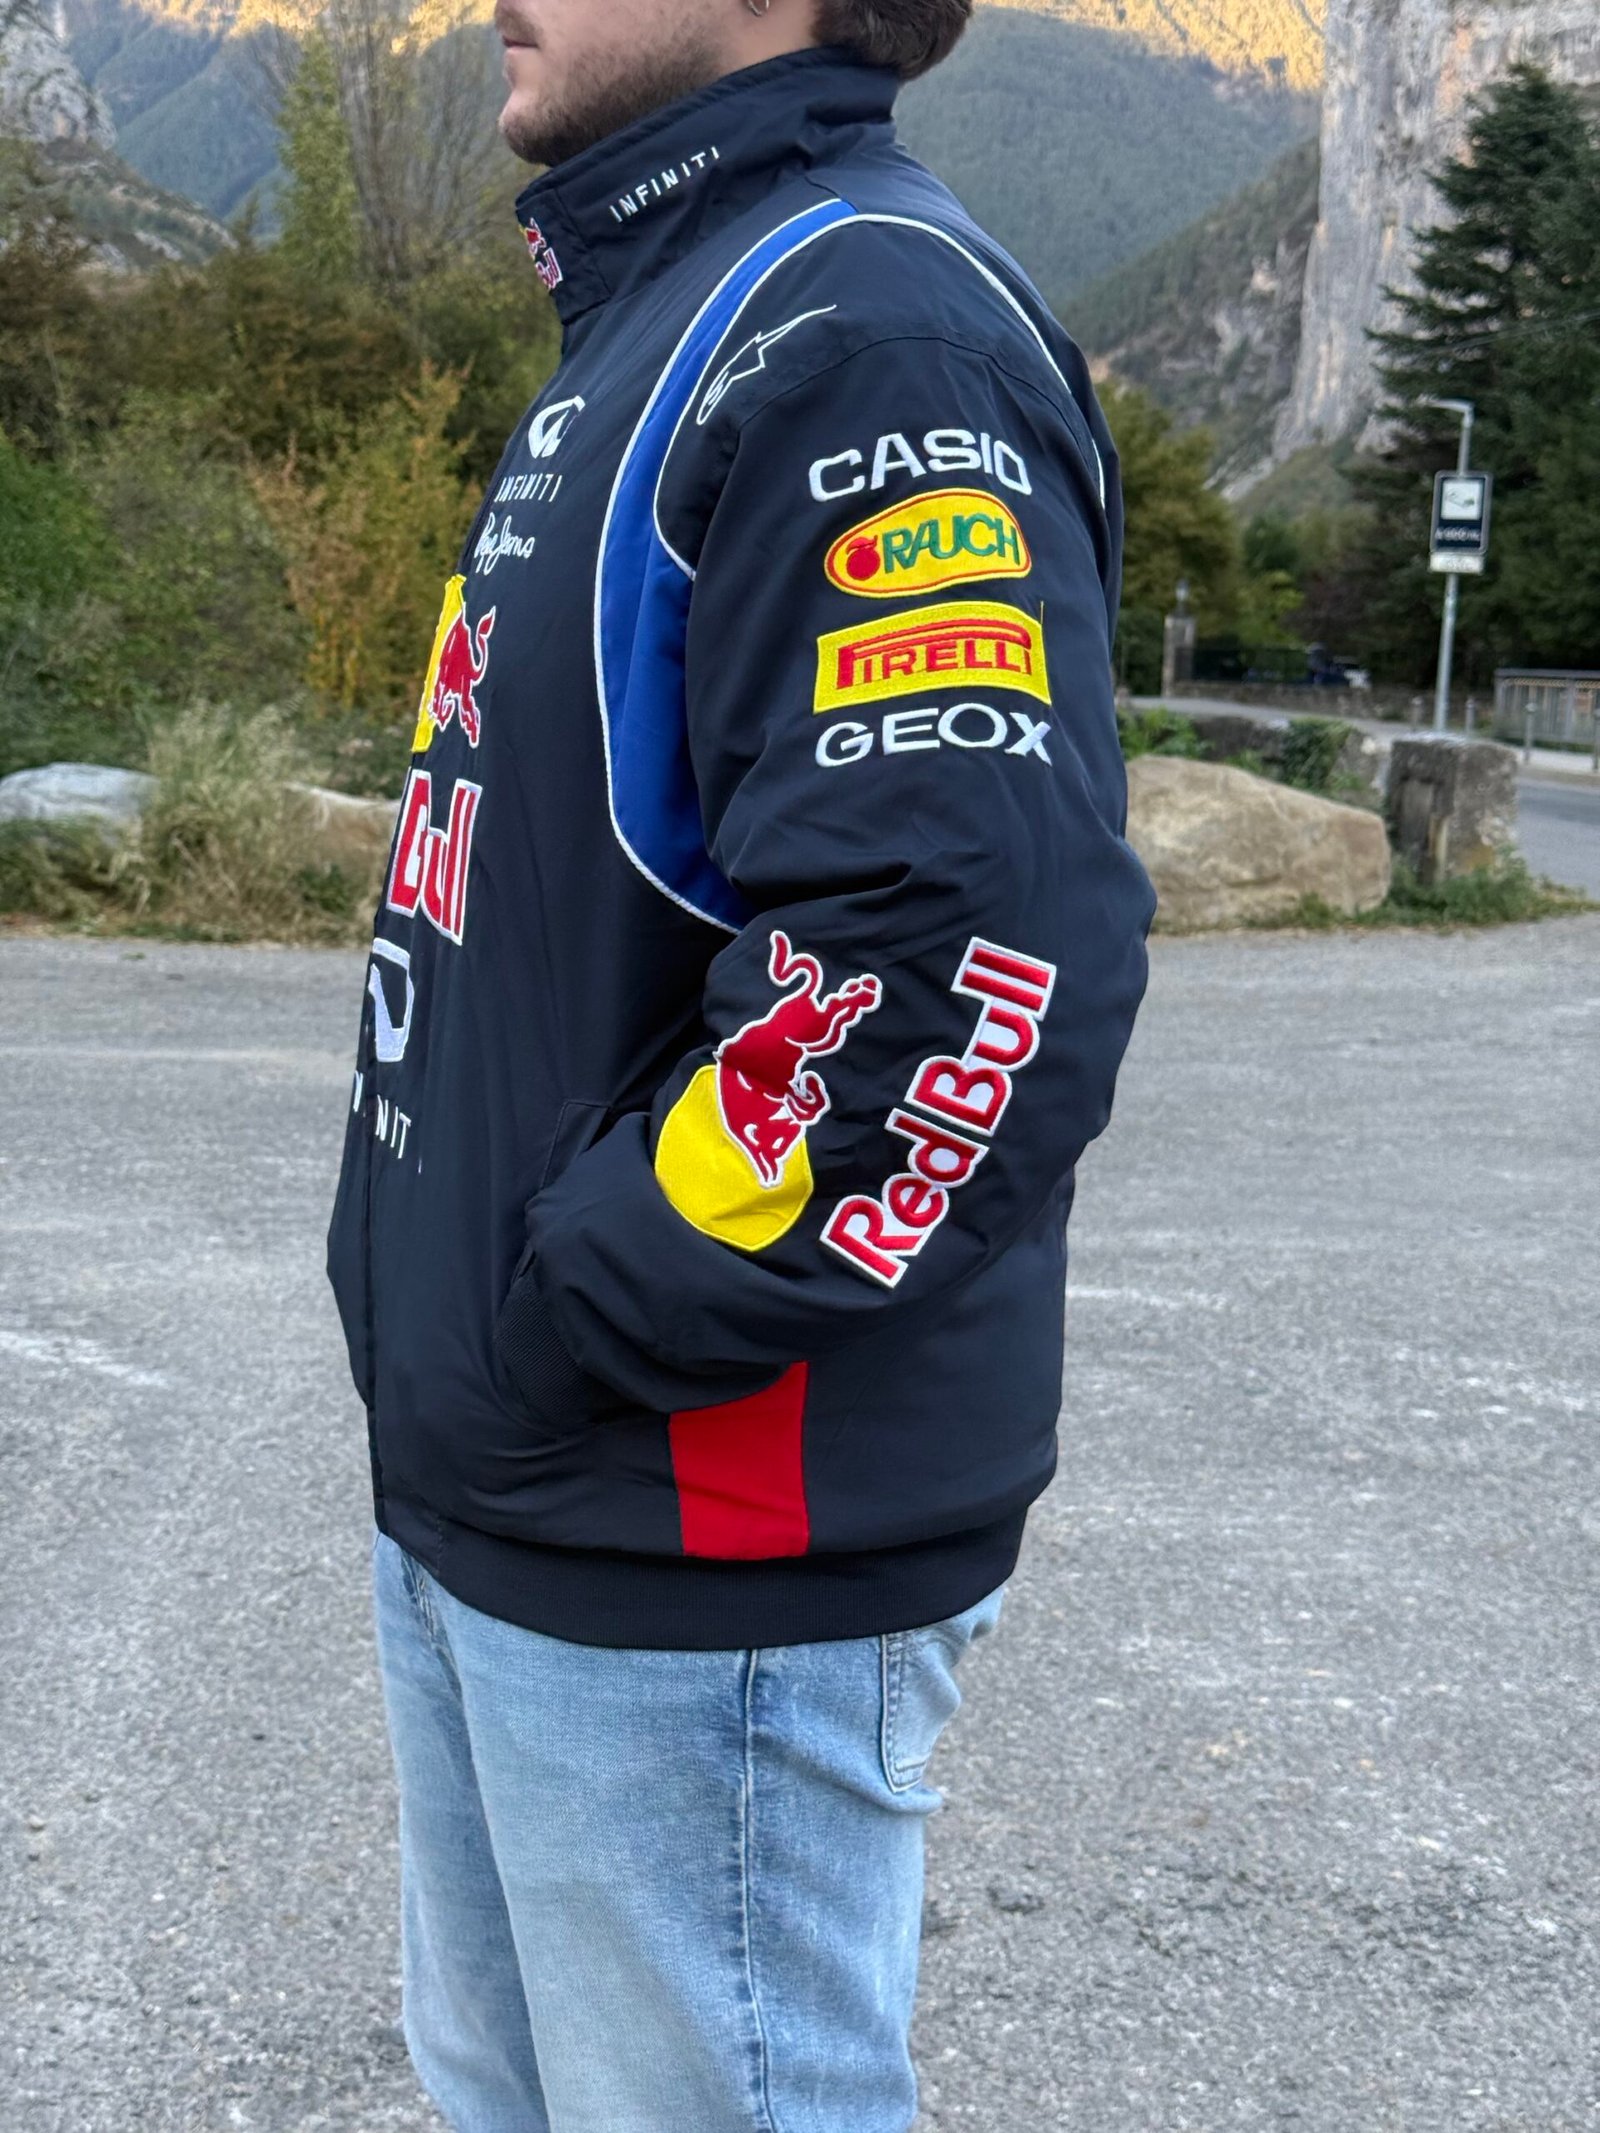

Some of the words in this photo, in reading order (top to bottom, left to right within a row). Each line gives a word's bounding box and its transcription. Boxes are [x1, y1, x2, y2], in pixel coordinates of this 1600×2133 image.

[609, 146, 721, 223] INFINITI
[808, 429, 1032, 501] CASIO
[882, 513, 1020, 574] RAUCH
[836, 618, 1031, 690] PIRELLI
[815, 703, 1052, 767] GEOX
[904, 937, 1057, 1136] Bull
[821, 1109, 988, 1288] Red
